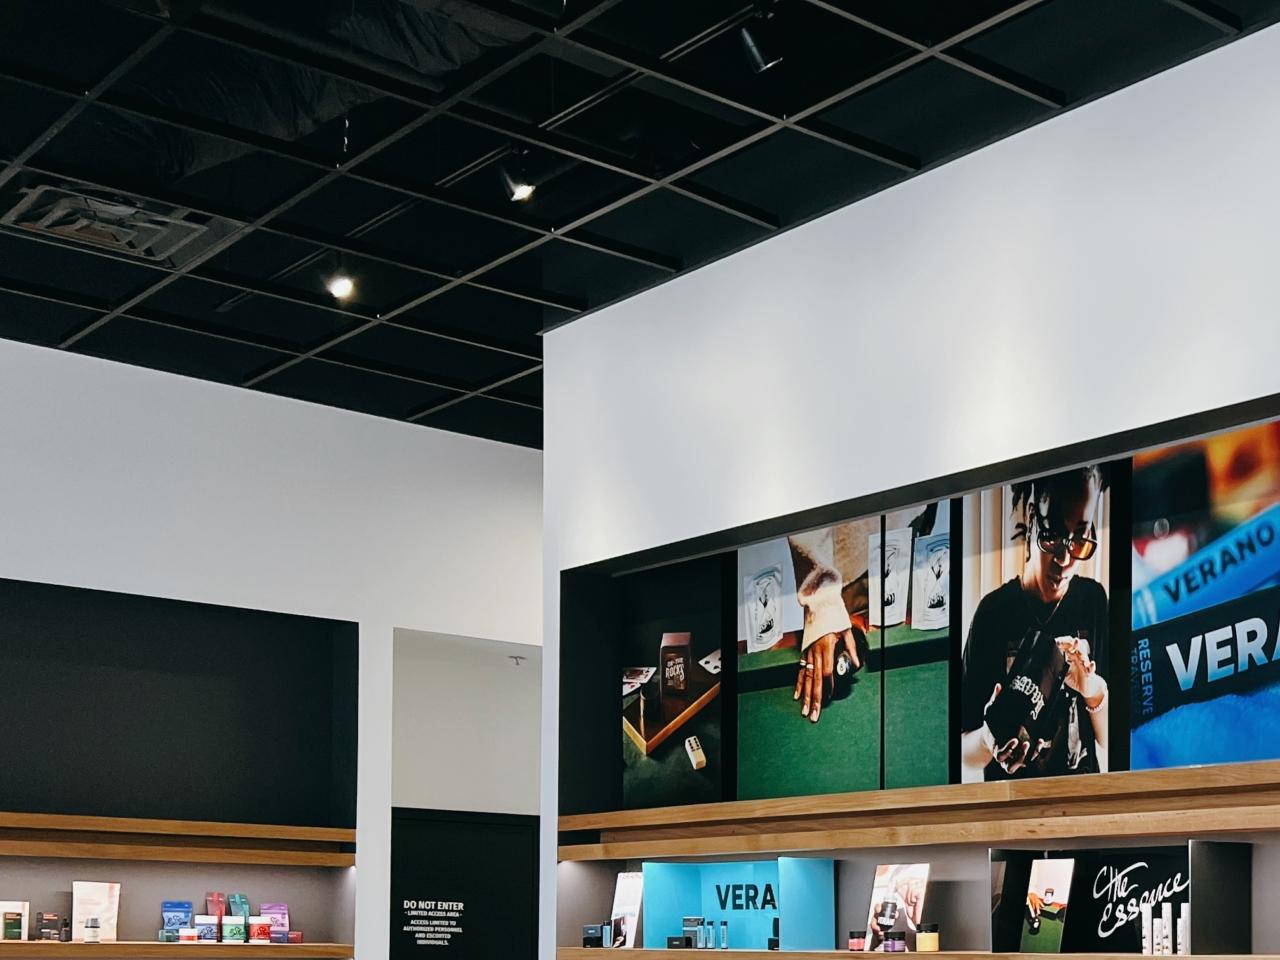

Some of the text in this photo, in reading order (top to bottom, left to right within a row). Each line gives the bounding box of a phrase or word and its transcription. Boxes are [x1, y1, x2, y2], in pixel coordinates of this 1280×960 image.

[1163, 521, 1275, 604] VERANO
[665, 663, 685, 681] ROCKS
[1138, 638, 1153, 715] RESERVE
[403, 900, 464, 911] DO NOT ENTER
[715, 884, 778, 910] VERA
